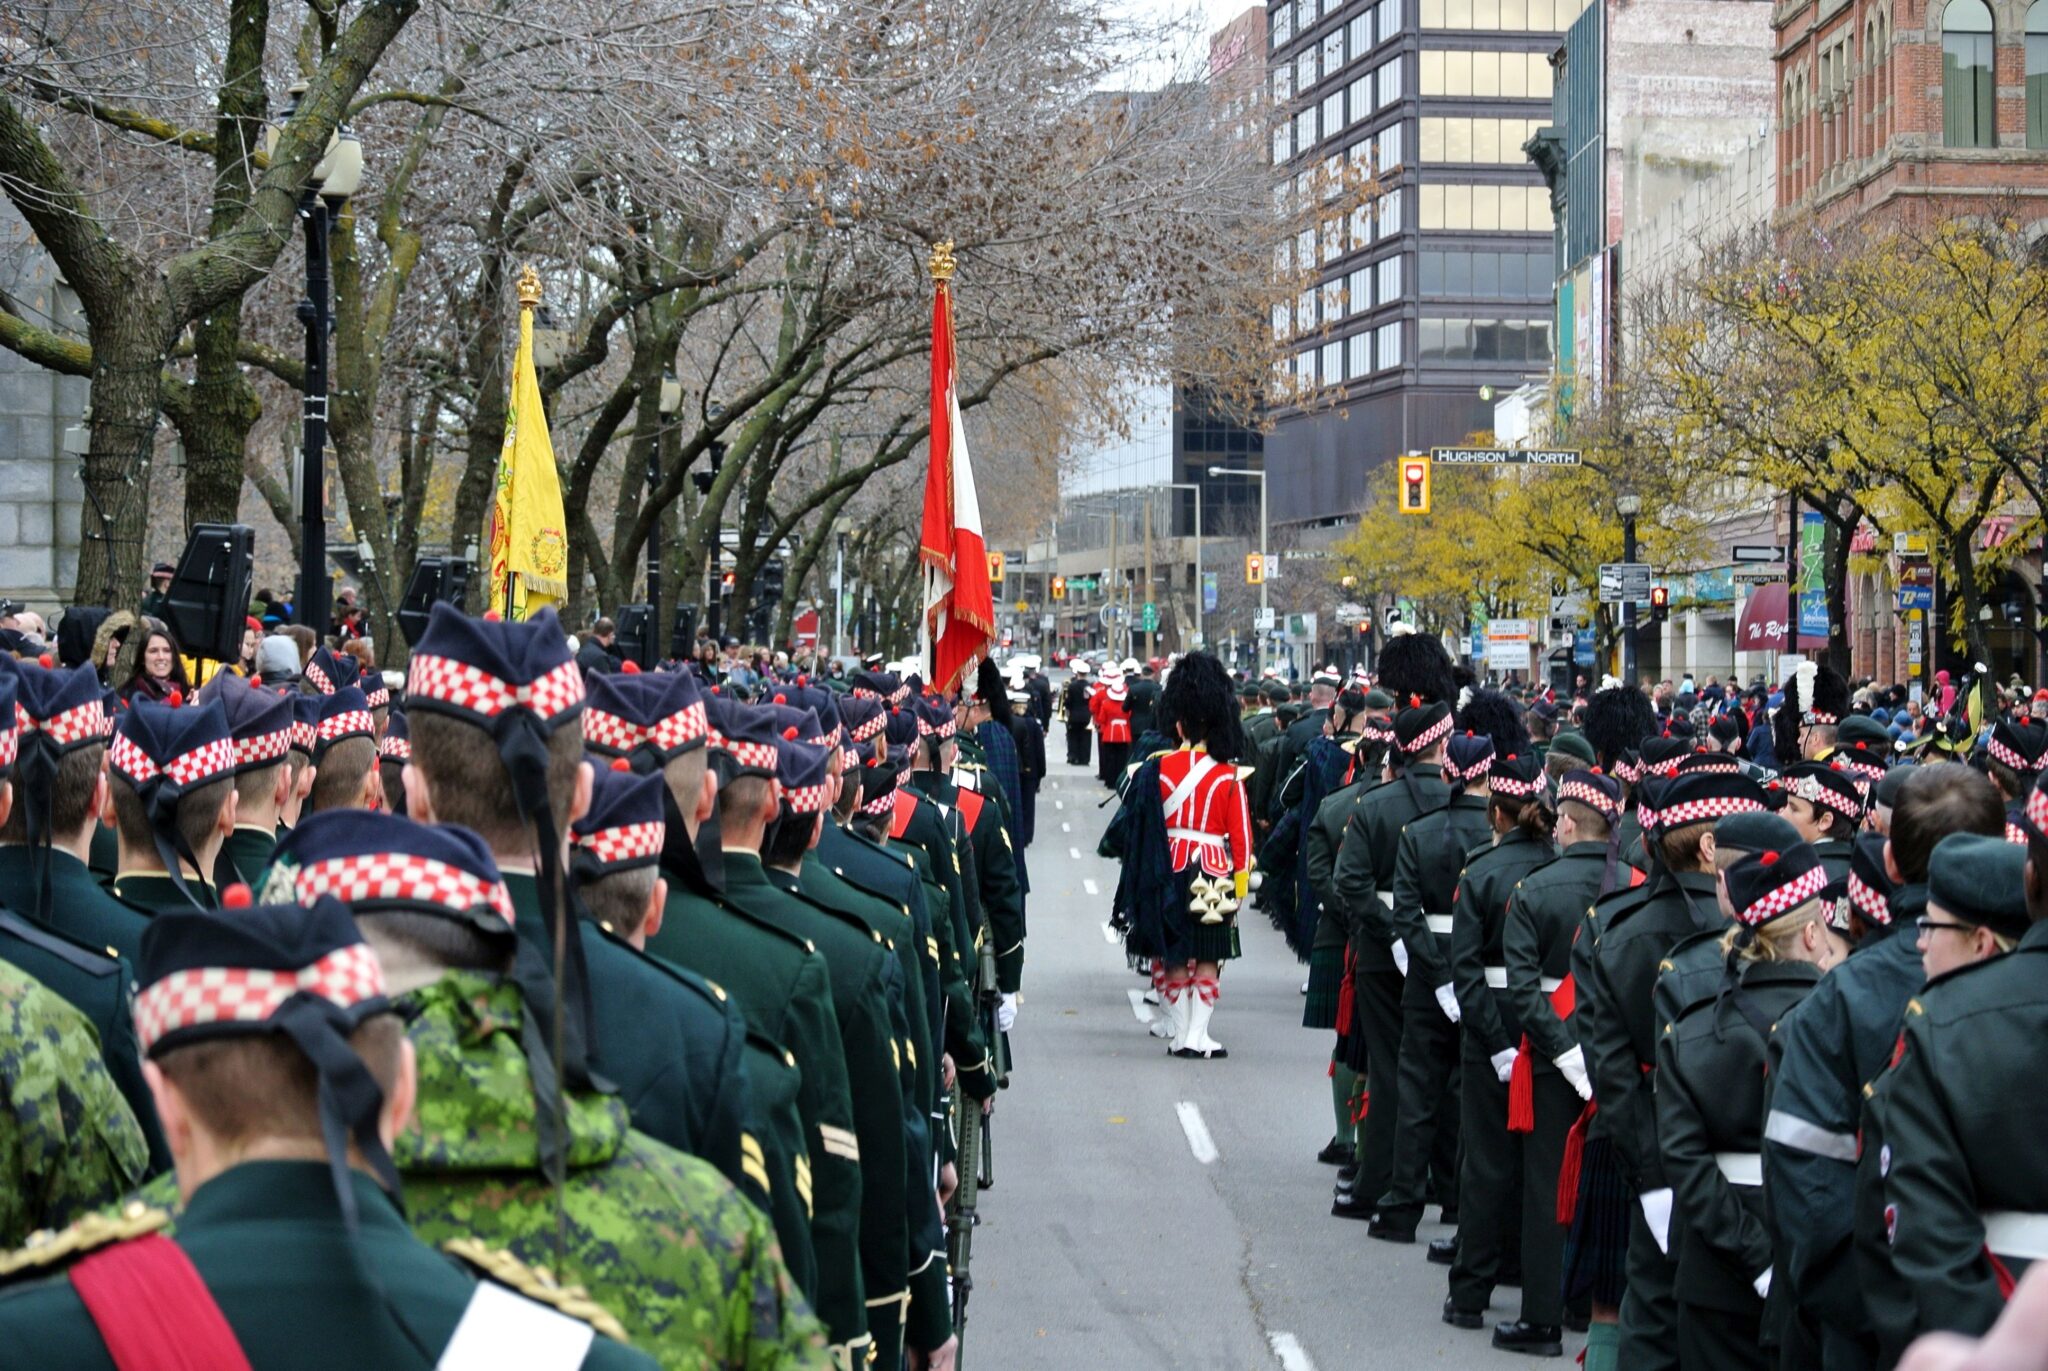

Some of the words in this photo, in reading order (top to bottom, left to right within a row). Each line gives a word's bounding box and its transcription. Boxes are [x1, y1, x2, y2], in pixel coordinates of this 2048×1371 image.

[1438, 450, 1505, 462] HUGHSON
[1527, 451, 1575, 463] NORTH
[1901, 566, 1917, 581] A
